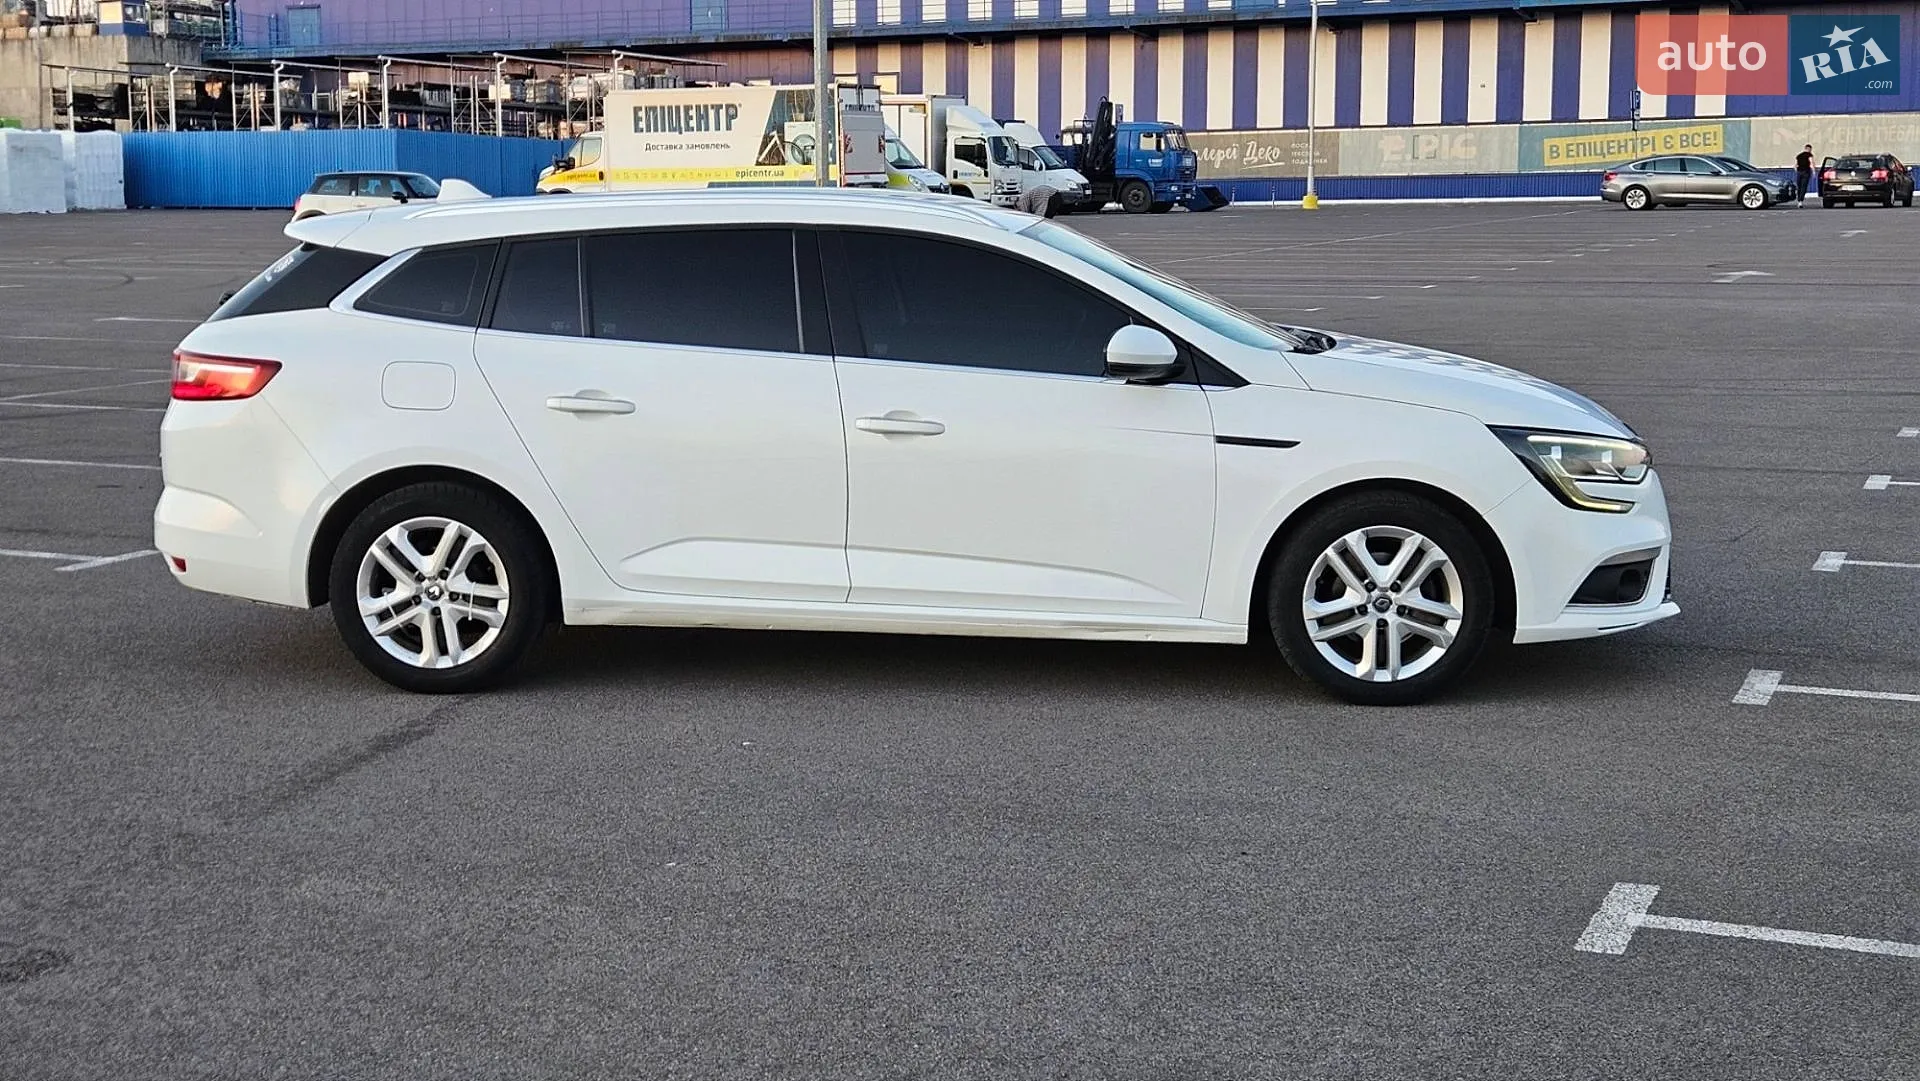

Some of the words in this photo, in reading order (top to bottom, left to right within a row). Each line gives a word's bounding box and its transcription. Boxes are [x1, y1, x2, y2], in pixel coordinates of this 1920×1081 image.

[633, 103, 738, 135] ЕПІЦЕНТР
[645, 142, 683, 152] Доставка
[686, 142, 730, 151] замовлень
[1197, 143, 1239, 169] лереї
[1243, 141, 1281, 166] Деко
[1549, 144, 1561, 160] В
[1566, 135, 1656, 159] ЕПІЦЕНТРІ
[1663, 134, 1674, 150] Є
[1680, 130, 1718, 149] ВСЕ!
[735, 168, 785, 179] epicentr.ua
